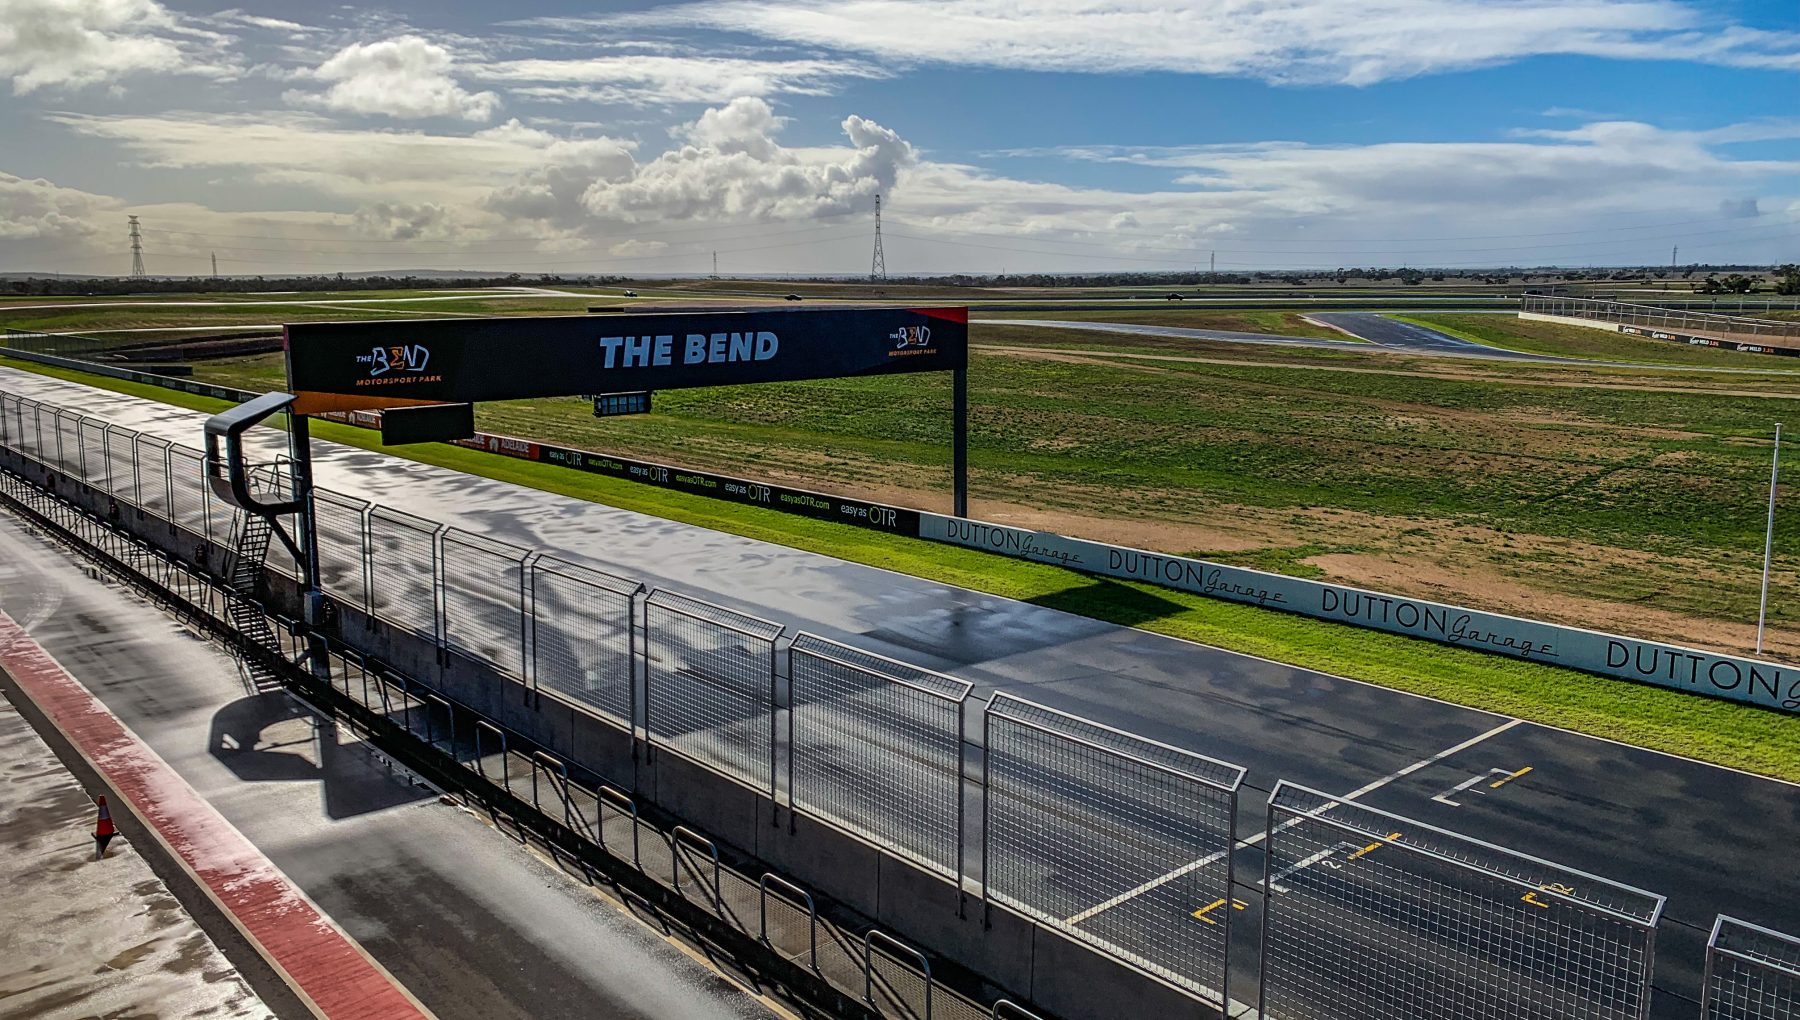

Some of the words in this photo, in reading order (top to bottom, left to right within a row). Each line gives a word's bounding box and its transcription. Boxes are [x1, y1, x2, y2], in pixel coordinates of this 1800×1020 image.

[600, 335, 673, 368] THE
[684, 331, 779, 365] BEND
[356, 377, 417, 386] MOTORSPORT
[566, 451, 582, 467] OTR
[629, 465, 642, 476] easy
[642, 468, 648, 476] as
[649, 466, 669, 483] OTR
[724, 482, 739, 495] easy
[739, 485, 747, 494] as
[748, 484, 771, 503] OTR
[780, 493, 830, 510] easyasOTR.com
[840, 503, 858, 518] easy
[858, 508, 867, 518] as
[868, 506, 897, 528] OTR
[947, 519, 1020, 550] DUTTON
[1020, 534, 1085, 564] Garage
[1109, 550, 1203, 587] DUTTON
[1204, 569, 1288, 604] Garage
[1322, 588, 1447, 635] DUTTON
[1447, 614, 1560, 656] Garage
[1606, 640, 1781, 700] DUTTON
